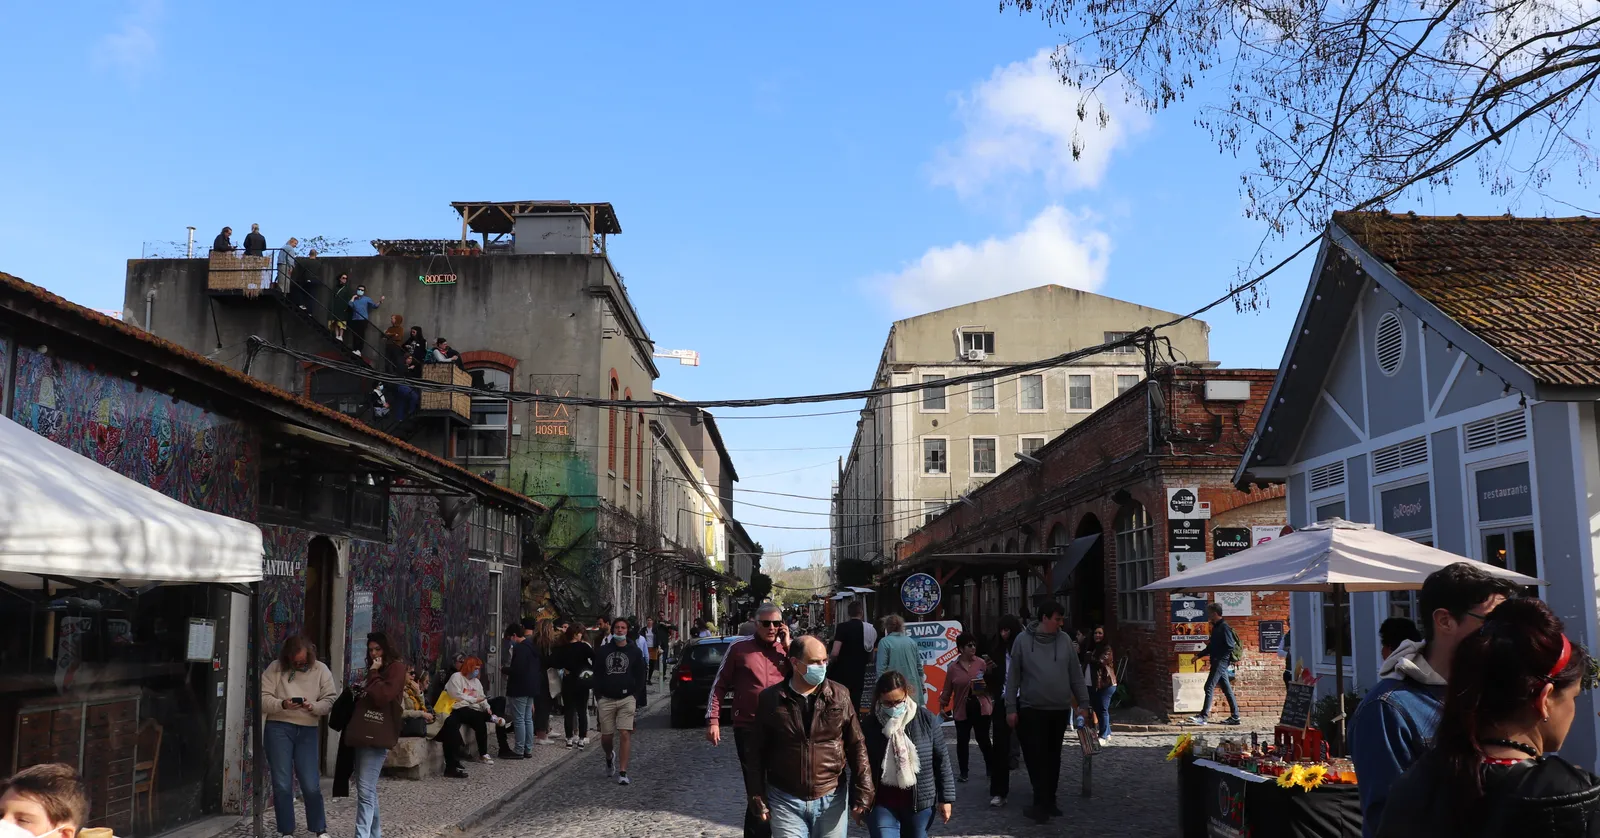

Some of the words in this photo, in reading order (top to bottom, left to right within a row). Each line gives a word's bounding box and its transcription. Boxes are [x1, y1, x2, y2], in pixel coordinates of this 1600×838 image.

[425, 274, 457, 283] ROOFTOP
[535, 389, 570, 417] LX
[535, 425, 570, 435] HOSTEL
[1483, 485, 1528, 499] restaurante
[913, 625, 940, 636] WAY
